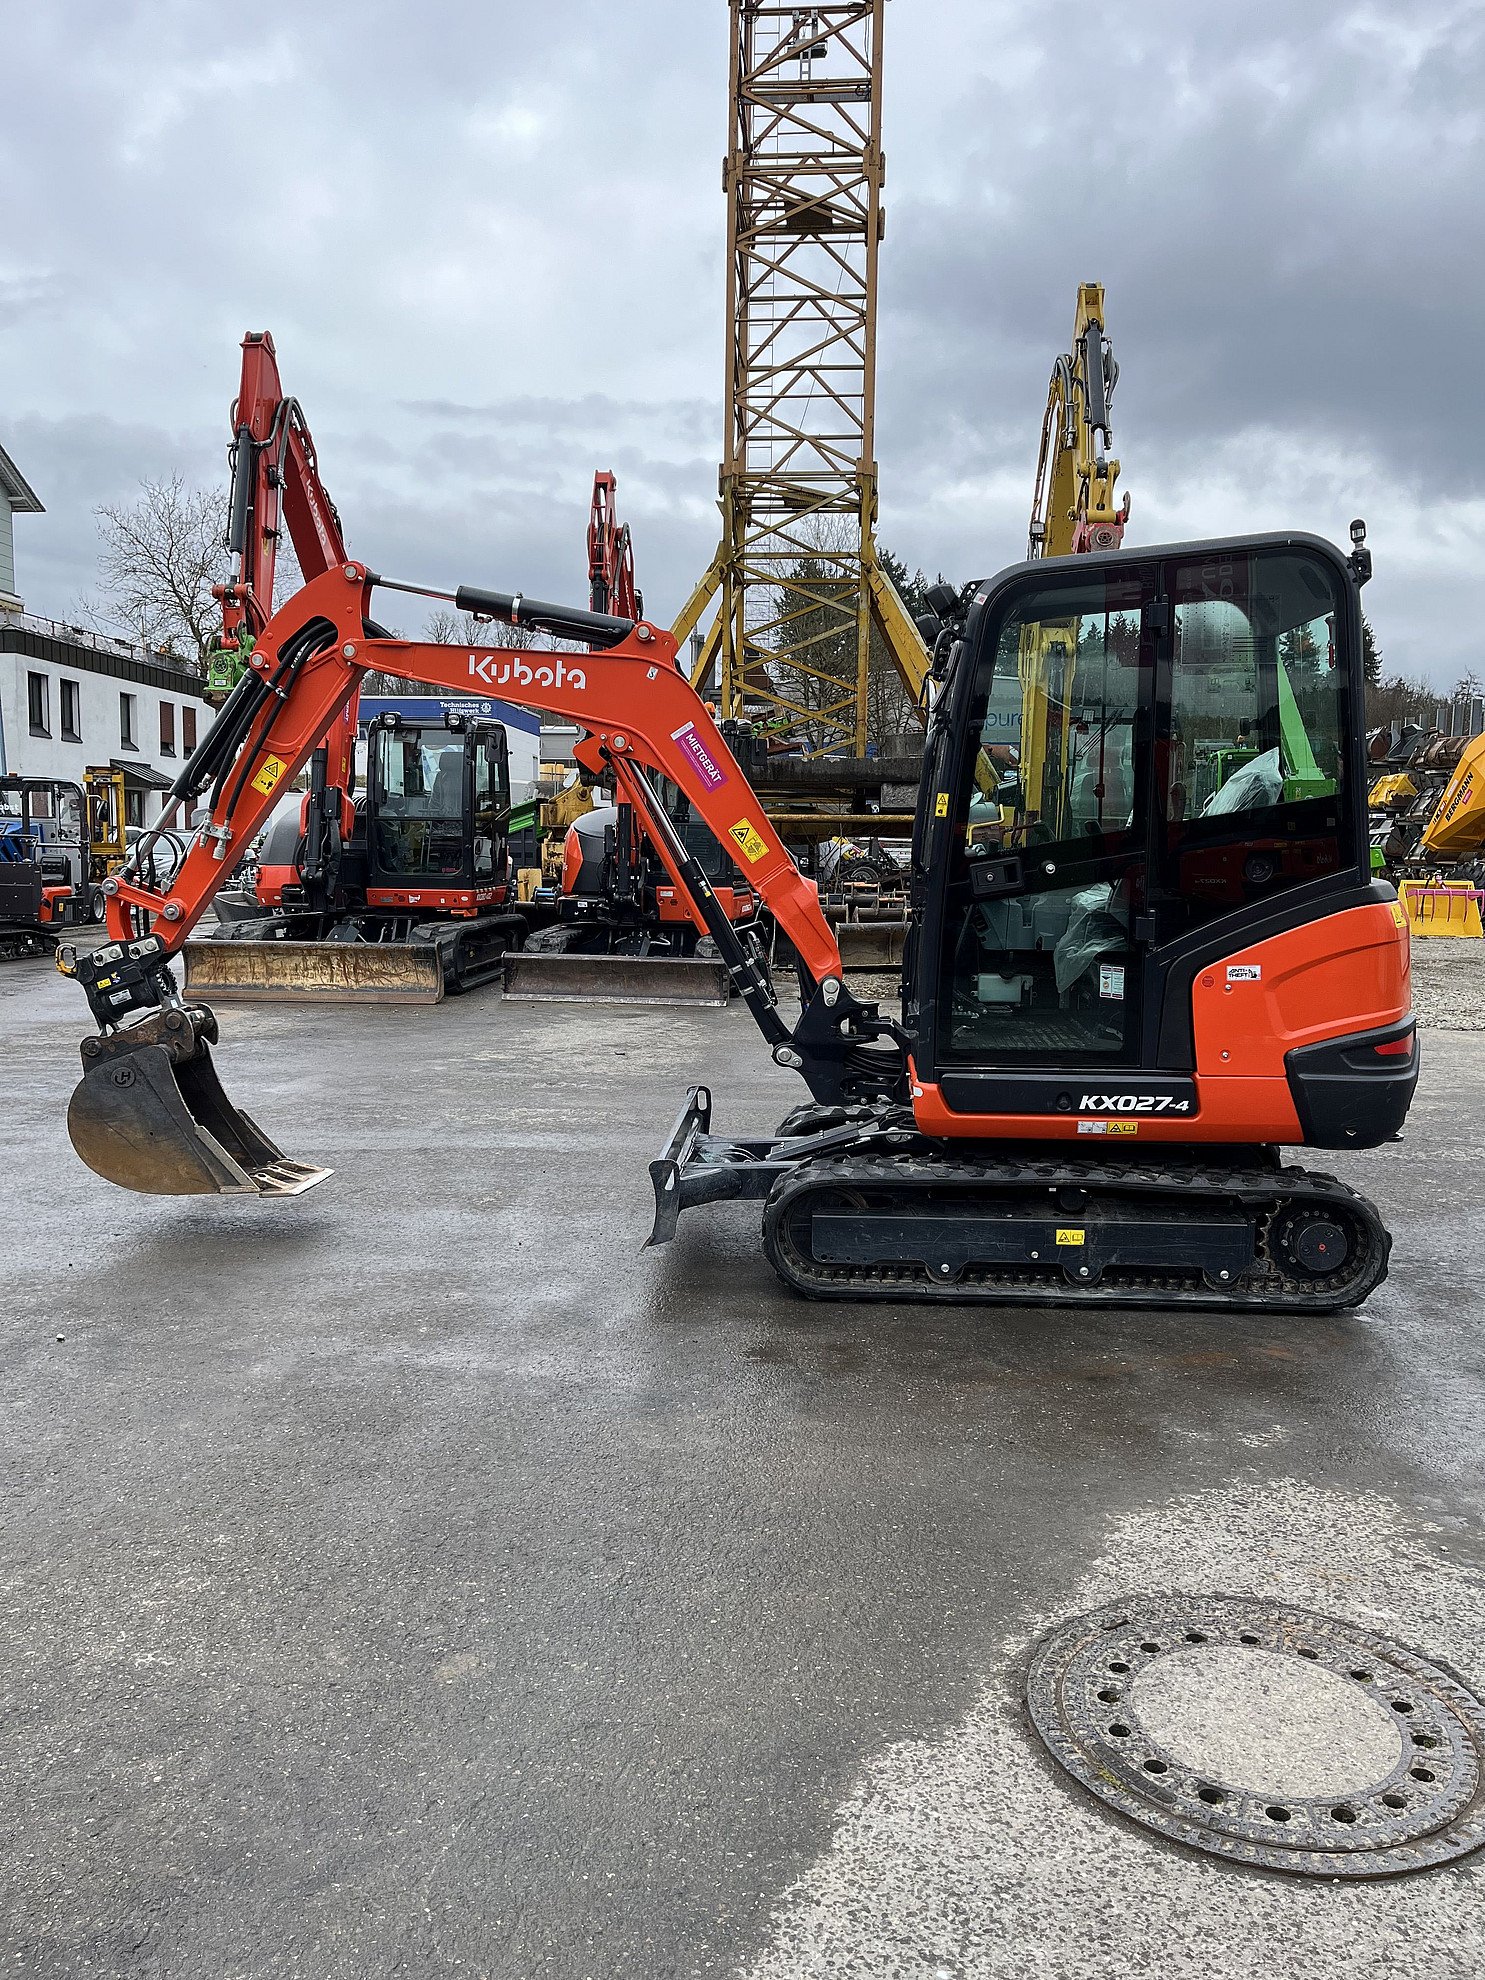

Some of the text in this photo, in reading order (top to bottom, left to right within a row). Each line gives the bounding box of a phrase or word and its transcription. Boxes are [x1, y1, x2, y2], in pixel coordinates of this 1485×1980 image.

[468, 654, 587, 690] Kubota
[685, 733, 722, 782] MIETGERÄT
[1445, 771, 1474, 822] BERGMANN
[1078, 1095, 1190, 1111] KX027-4
